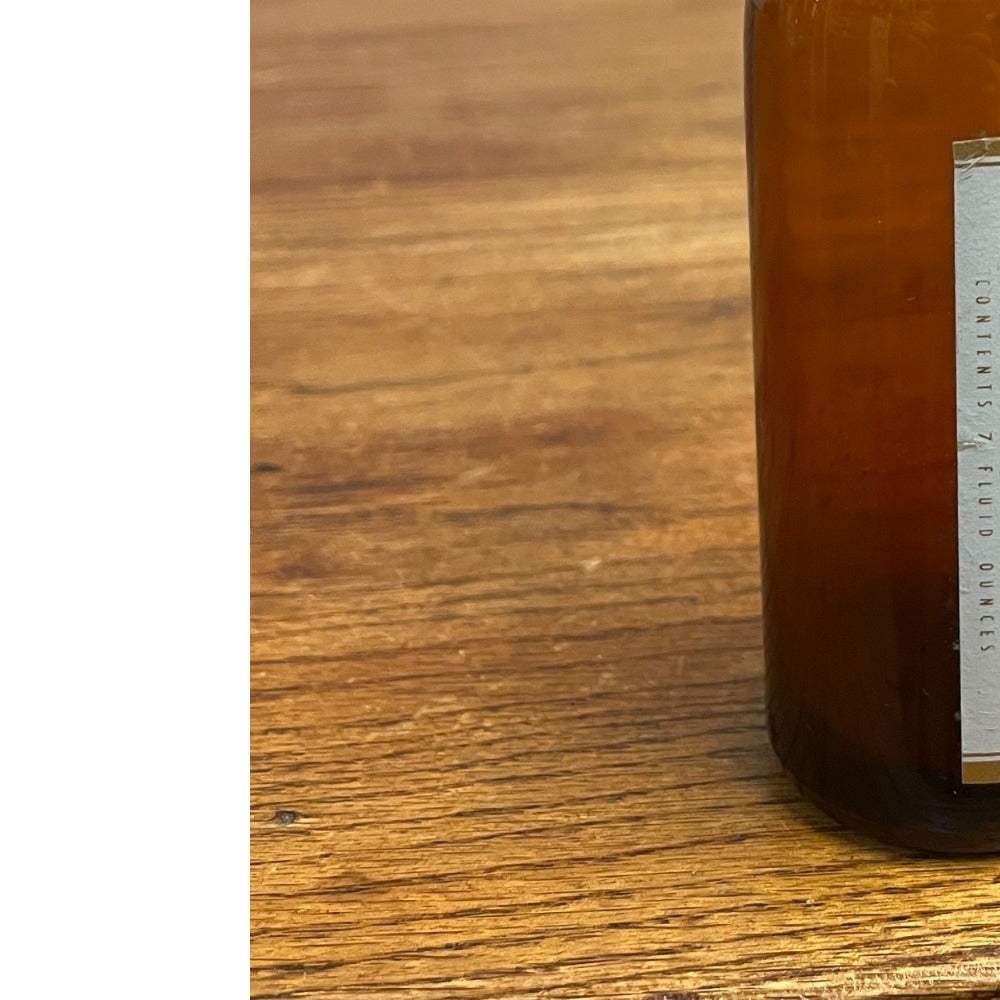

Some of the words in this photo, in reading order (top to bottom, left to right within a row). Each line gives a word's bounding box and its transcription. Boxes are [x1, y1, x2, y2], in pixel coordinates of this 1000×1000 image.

[975, 279, 992, 408] CONTENTS
[978, 432, 993, 441] 7
[978, 466, 993, 537] FLUID
[979, 563, 995, 651] OUNCES
